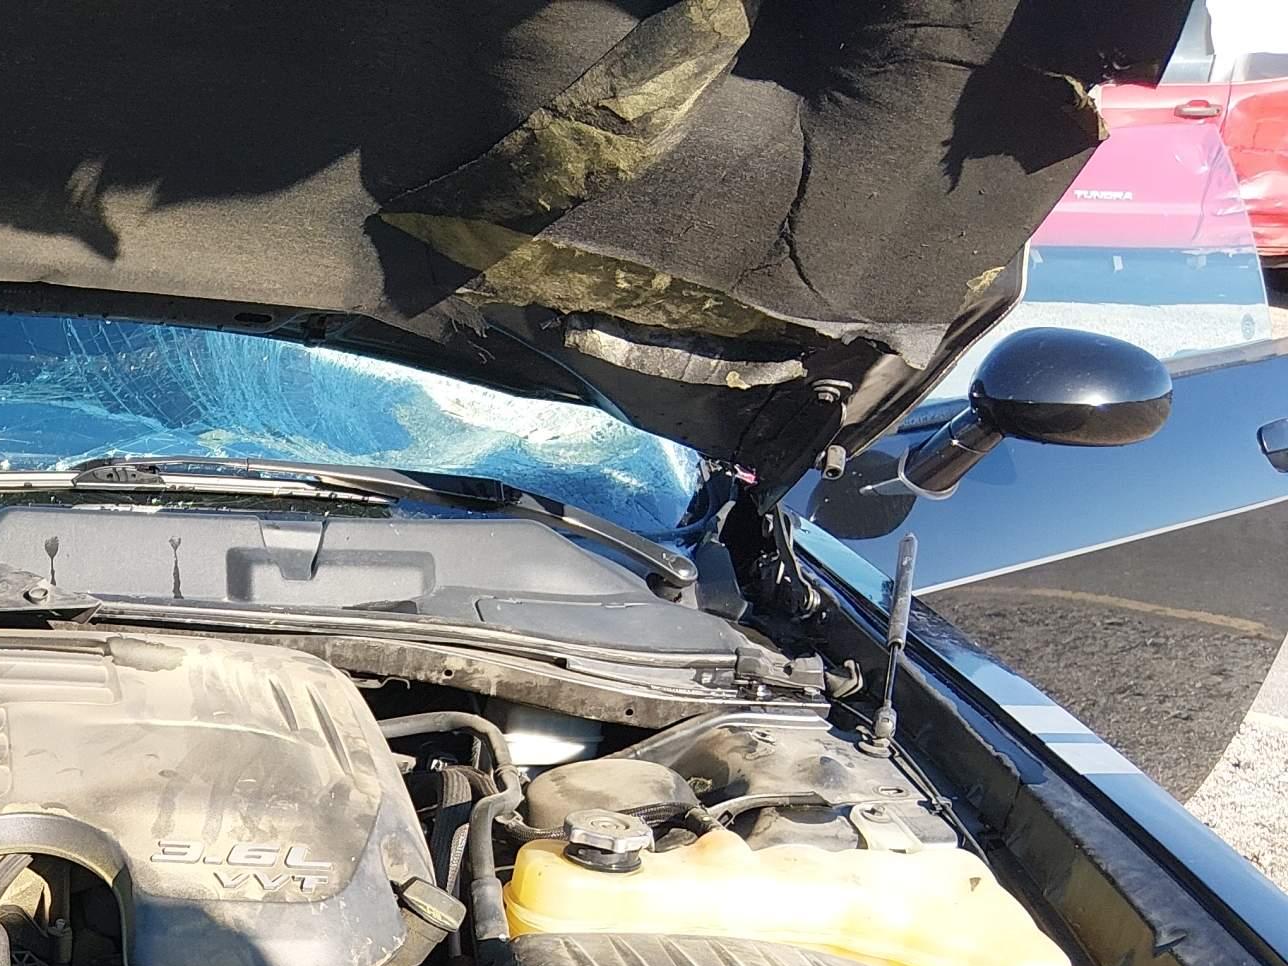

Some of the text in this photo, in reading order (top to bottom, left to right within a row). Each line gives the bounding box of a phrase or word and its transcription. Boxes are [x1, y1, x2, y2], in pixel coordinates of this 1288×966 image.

[1074, 190, 1133, 200] TUNDRA
[150, 840, 334, 870] 3.6L
[213, 872, 329, 891] VVT
